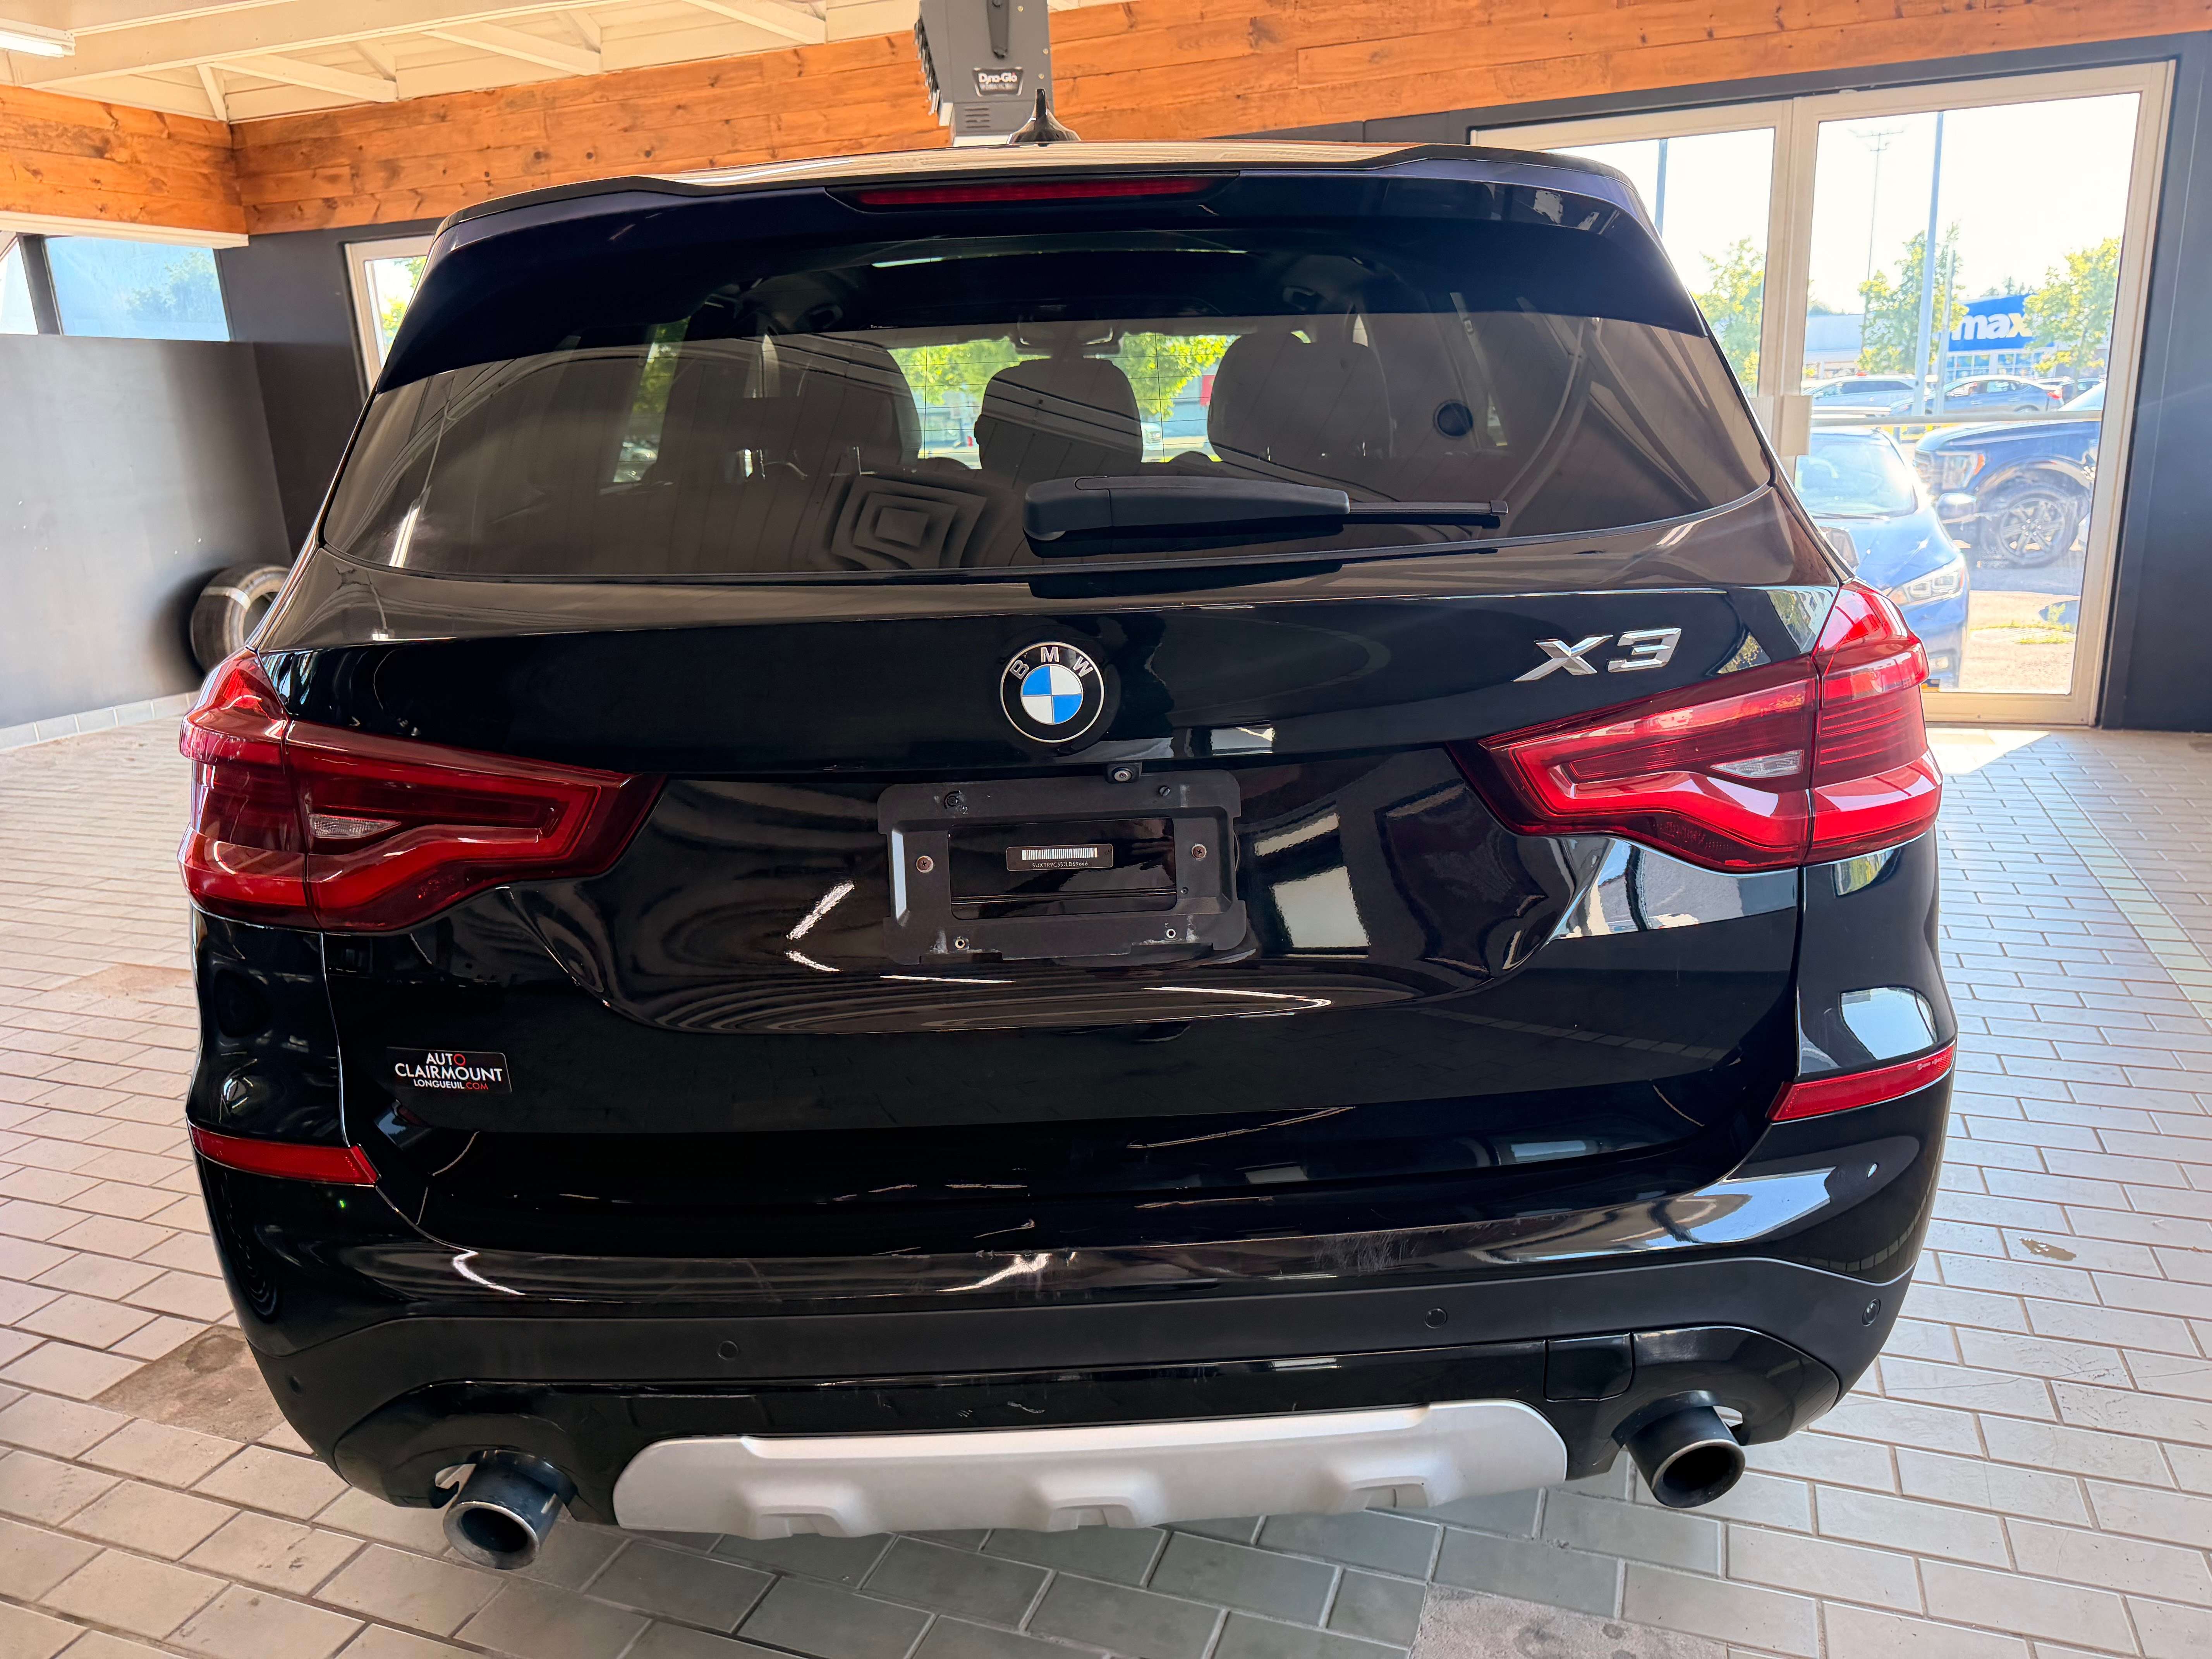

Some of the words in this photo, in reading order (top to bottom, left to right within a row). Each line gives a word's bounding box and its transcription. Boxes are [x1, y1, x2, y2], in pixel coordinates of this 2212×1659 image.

[1951, 312, 2039, 341] max
[1009, 646, 1094, 680] BMW
[1512, 627, 1682, 682] X3
[426, 1052, 465, 1066] AUTO
[395, 1063, 502, 1082] CLAIRMOUNT
[413, 1079, 489, 1091] LONGUEUIL.COM
